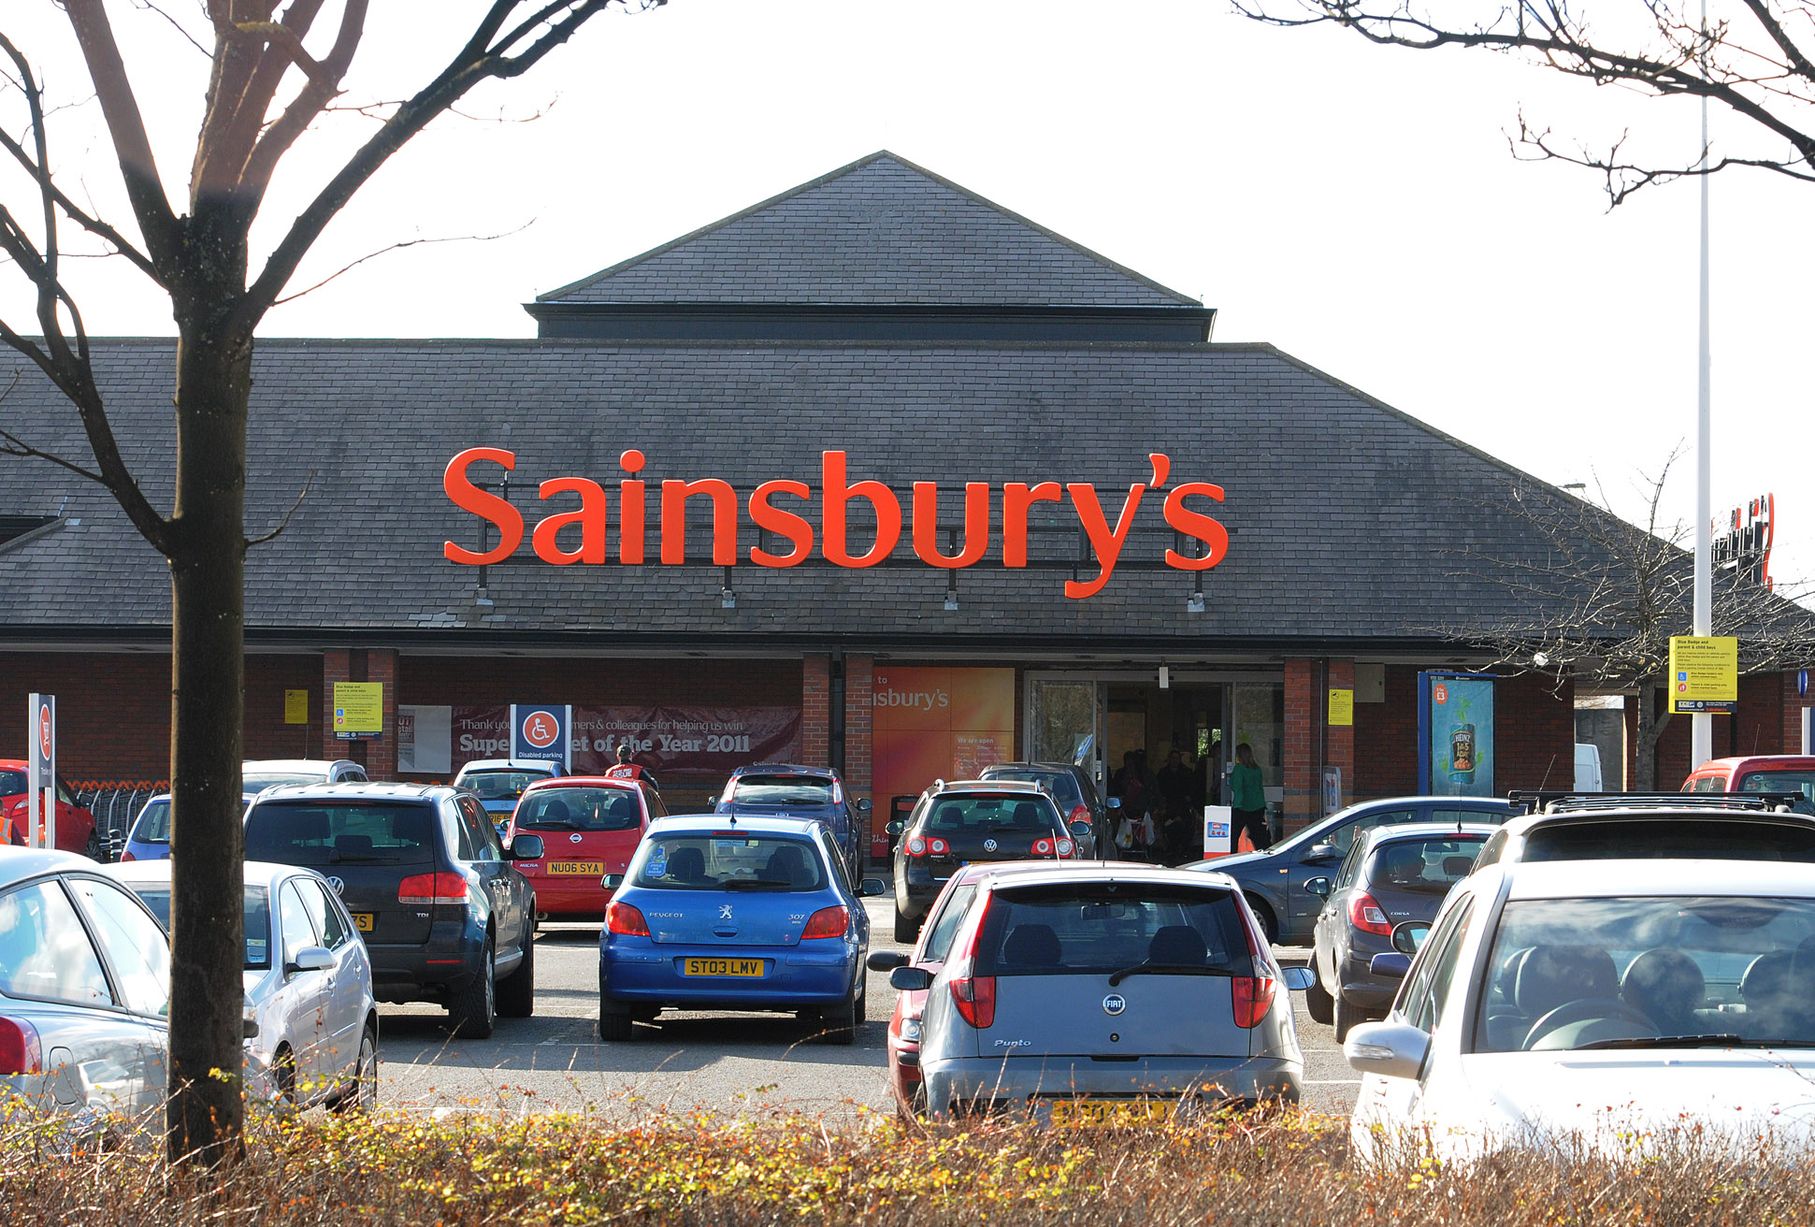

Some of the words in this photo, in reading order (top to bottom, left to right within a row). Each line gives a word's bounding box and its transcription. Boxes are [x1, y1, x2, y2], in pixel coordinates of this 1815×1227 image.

[443, 446, 1229, 600] Sainsbury's
[878, 676, 888, 684] to
[459, 719, 493, 730] Thank
[597, 719, 606, 731] &
[606, 719, 657, 734] colleagues
[657, 719, 673, 731] for
[673, 719, 710, 733] helping
[710, 721, 722, 731] us
[723, 720, 744, 731] win
[593, 734, 615, 753] of
[621, 735, 653, 753] the
[658, 734, 702, 753] Year
[706, 734, 750, 753] 2011
[518, 751, 542, 759] Disabled
[542, 751, 563, 760] parking
[551, 863, 577, 873] NU06
[580, 863, 599, 873] SYA
[788, 913, 805, 921] 307
[690, 960, 727, 974] ST03
[730, 961, 758, 975] LMV
[1106, 1000, 1122, 1008] FIAT
[994, 1039, 1032, 1047] Punto
